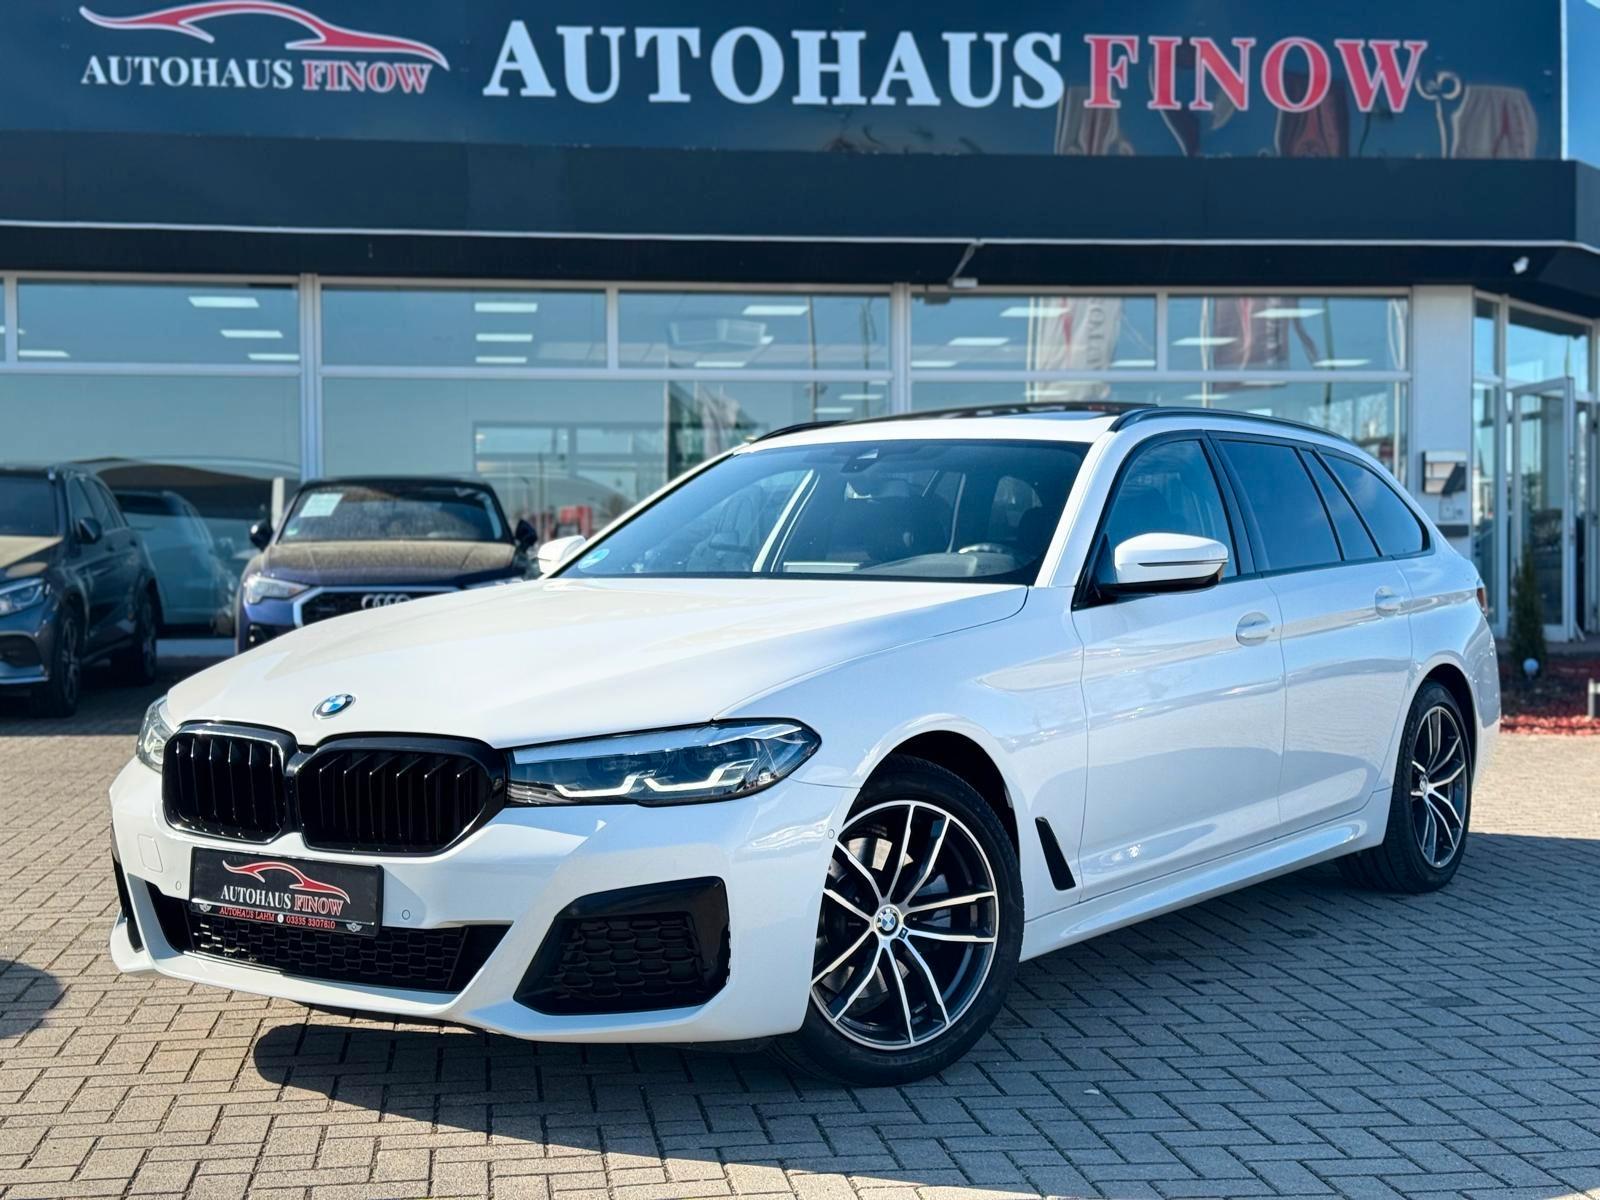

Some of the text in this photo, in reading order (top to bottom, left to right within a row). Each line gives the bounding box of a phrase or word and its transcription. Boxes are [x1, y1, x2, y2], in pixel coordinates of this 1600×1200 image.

[81, 55, 431, 95] AUTOHAUS FINOW
[482, 20, 1427, 114] AUTOHAUS FINOW
[219, 907, 254, 919] AUTOHAUS
[220, 885, 344, 916] AUTOHAUS FINOW
